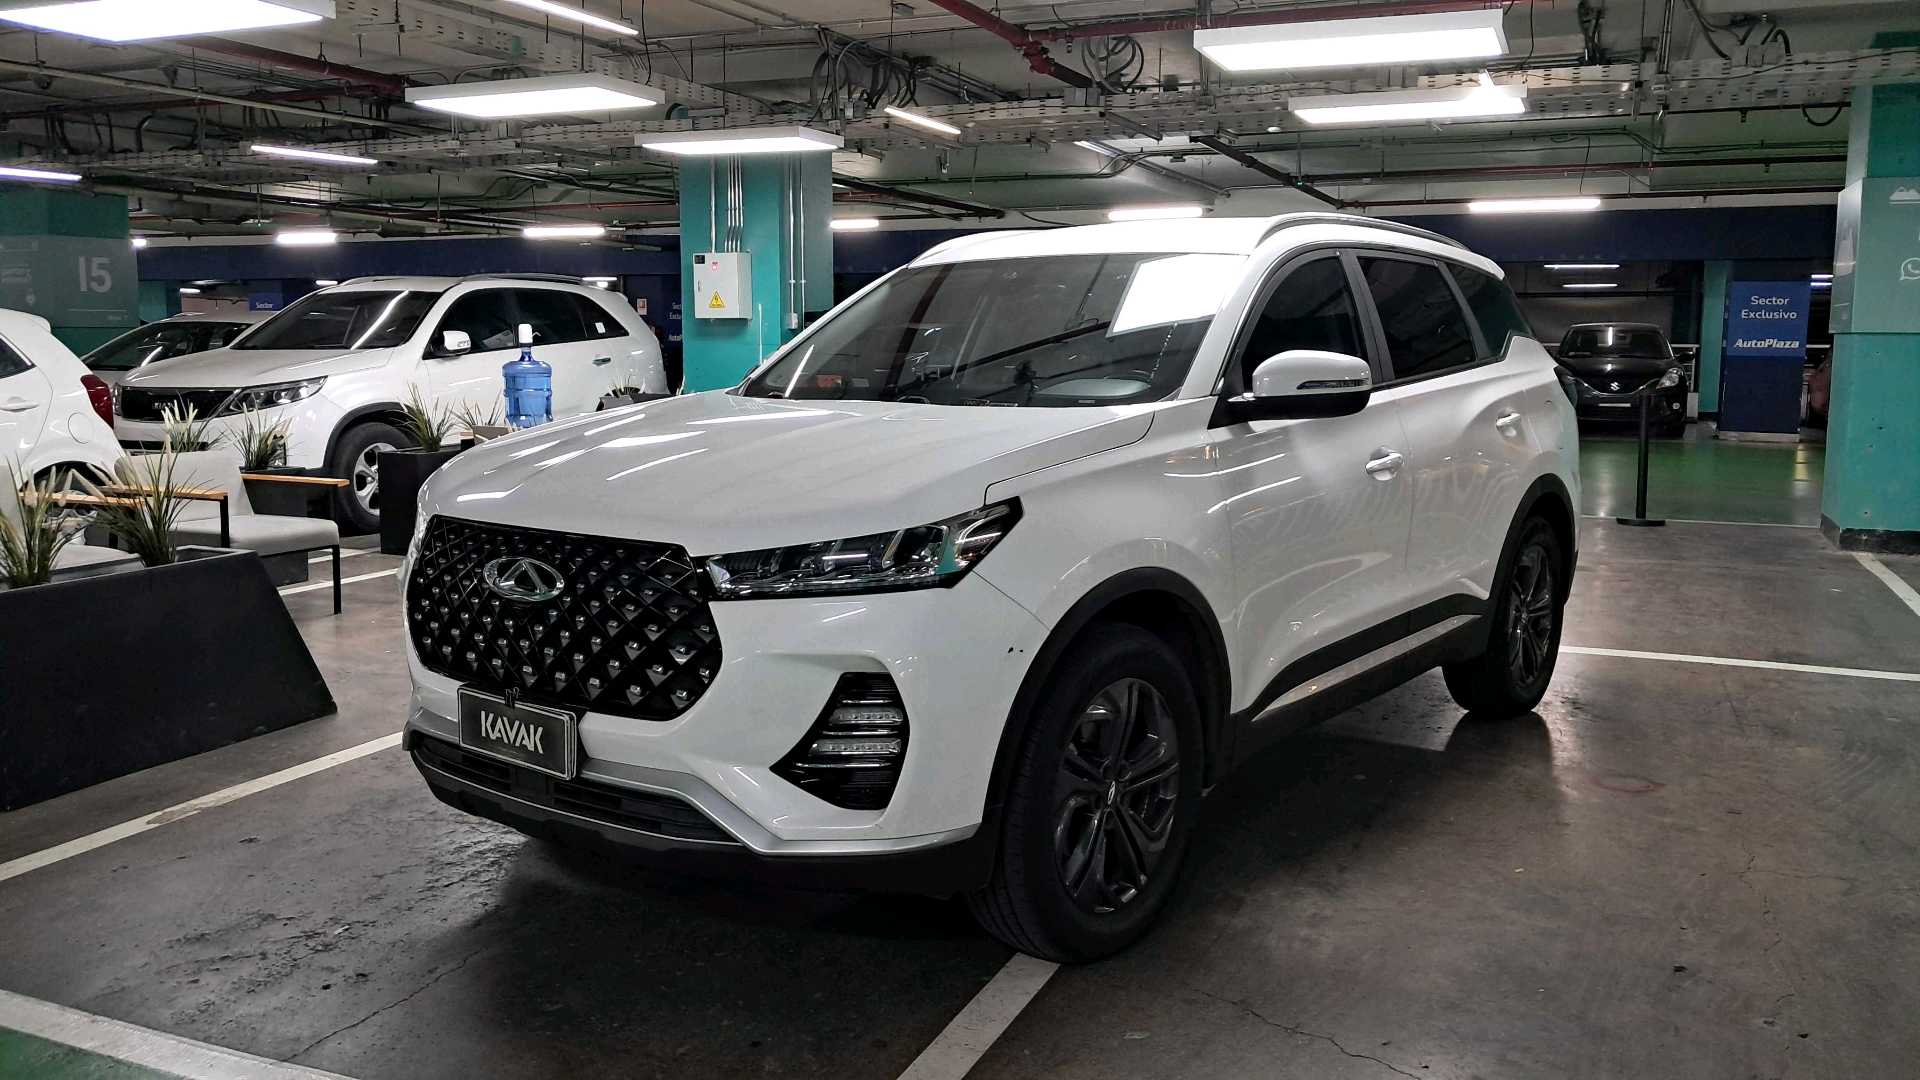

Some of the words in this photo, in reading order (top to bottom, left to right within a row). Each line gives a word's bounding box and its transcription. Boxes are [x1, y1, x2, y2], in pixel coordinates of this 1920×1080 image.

[79, 256, 112, 292] 15
[1751, 295, 1789, 305] Sector
[1741, 309, 1798, 319] Exclusivo
[1734, 338, 1800, 348] AutoPlaza
[480, 710, 544, 754] KAVAK
